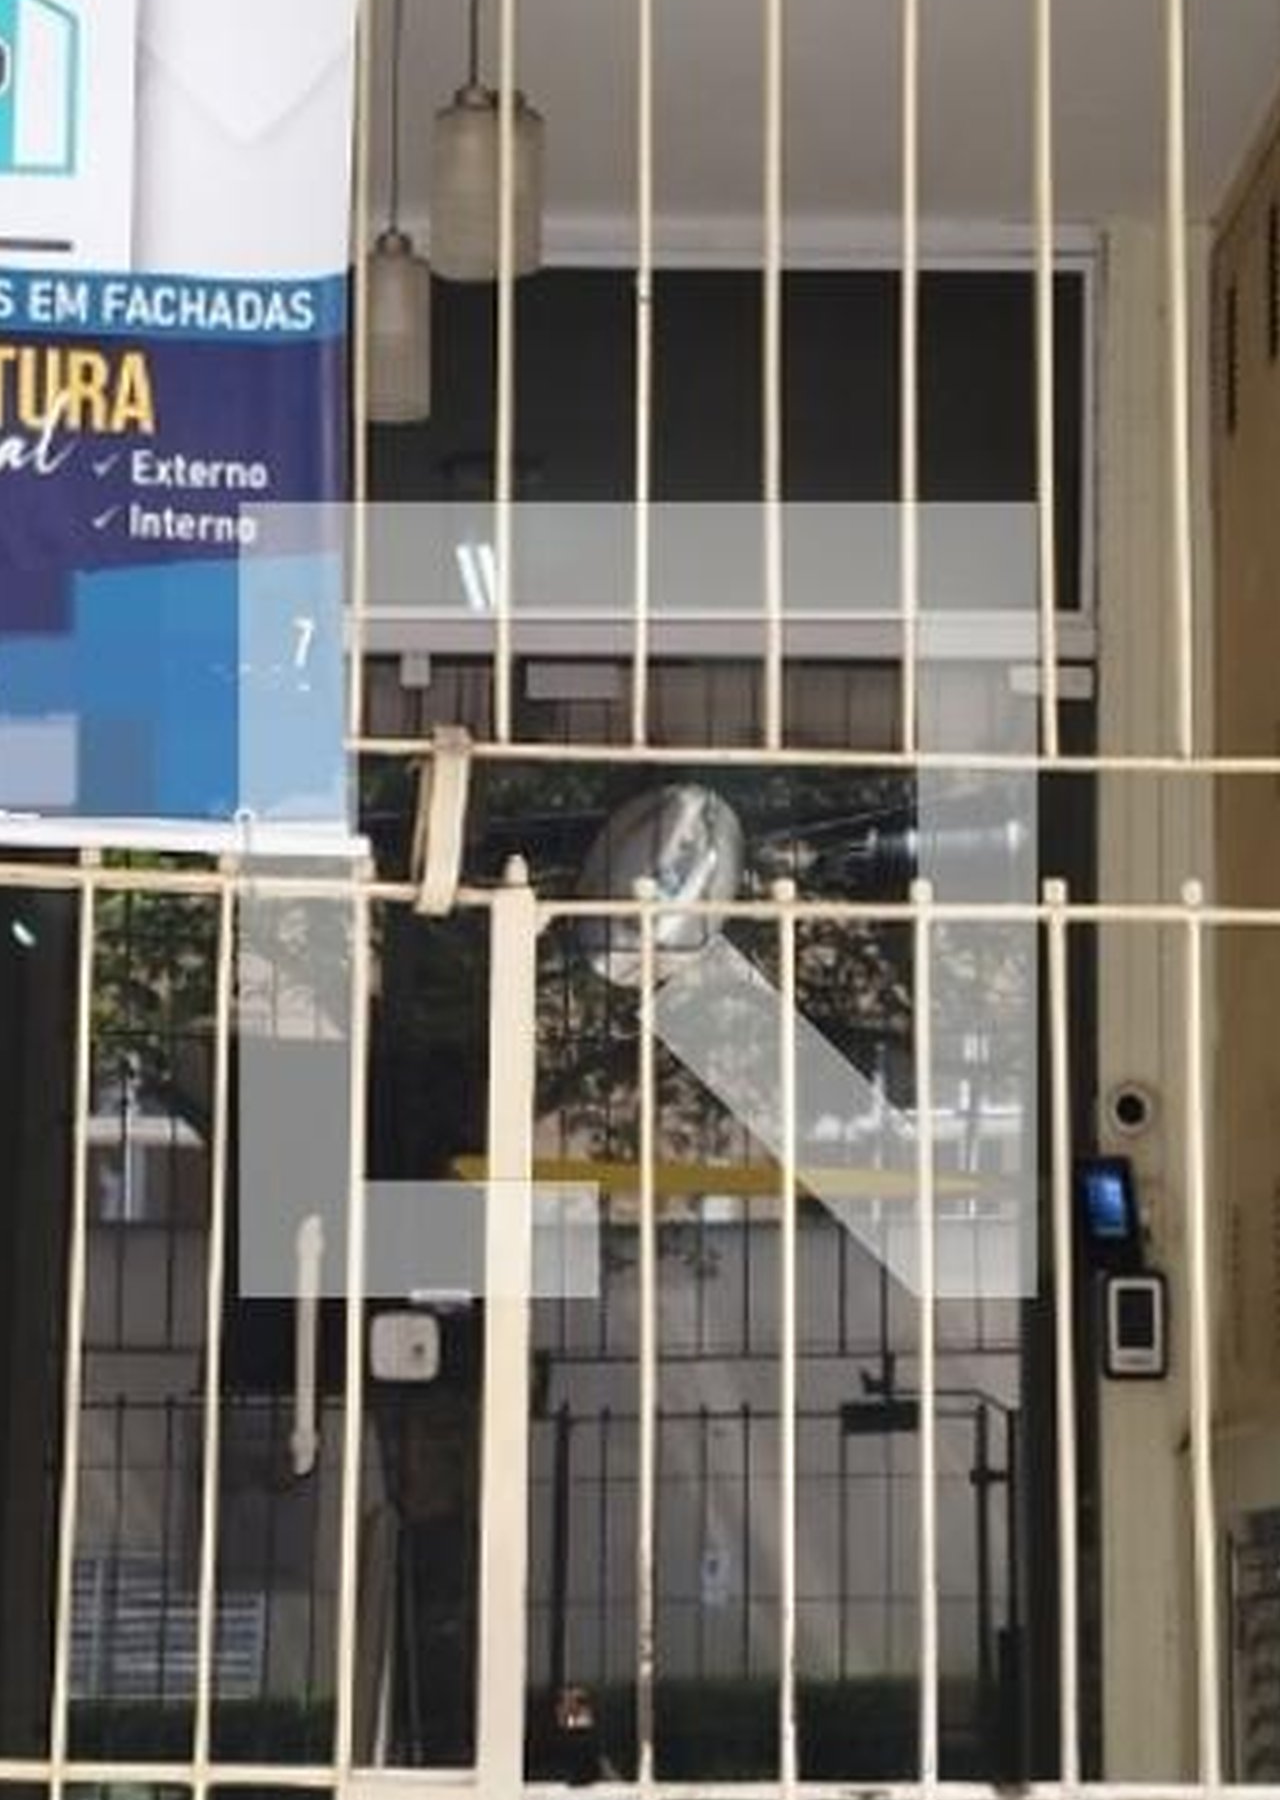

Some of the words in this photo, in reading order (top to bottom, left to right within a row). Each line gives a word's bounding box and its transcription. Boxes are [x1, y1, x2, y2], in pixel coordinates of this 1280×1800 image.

[28, 279, 88, 324] EM
[101, 283, 315, 332] FACHADAS
[131, 449, 268, 490] Externo
[129, 503, 257, 545] Interno
